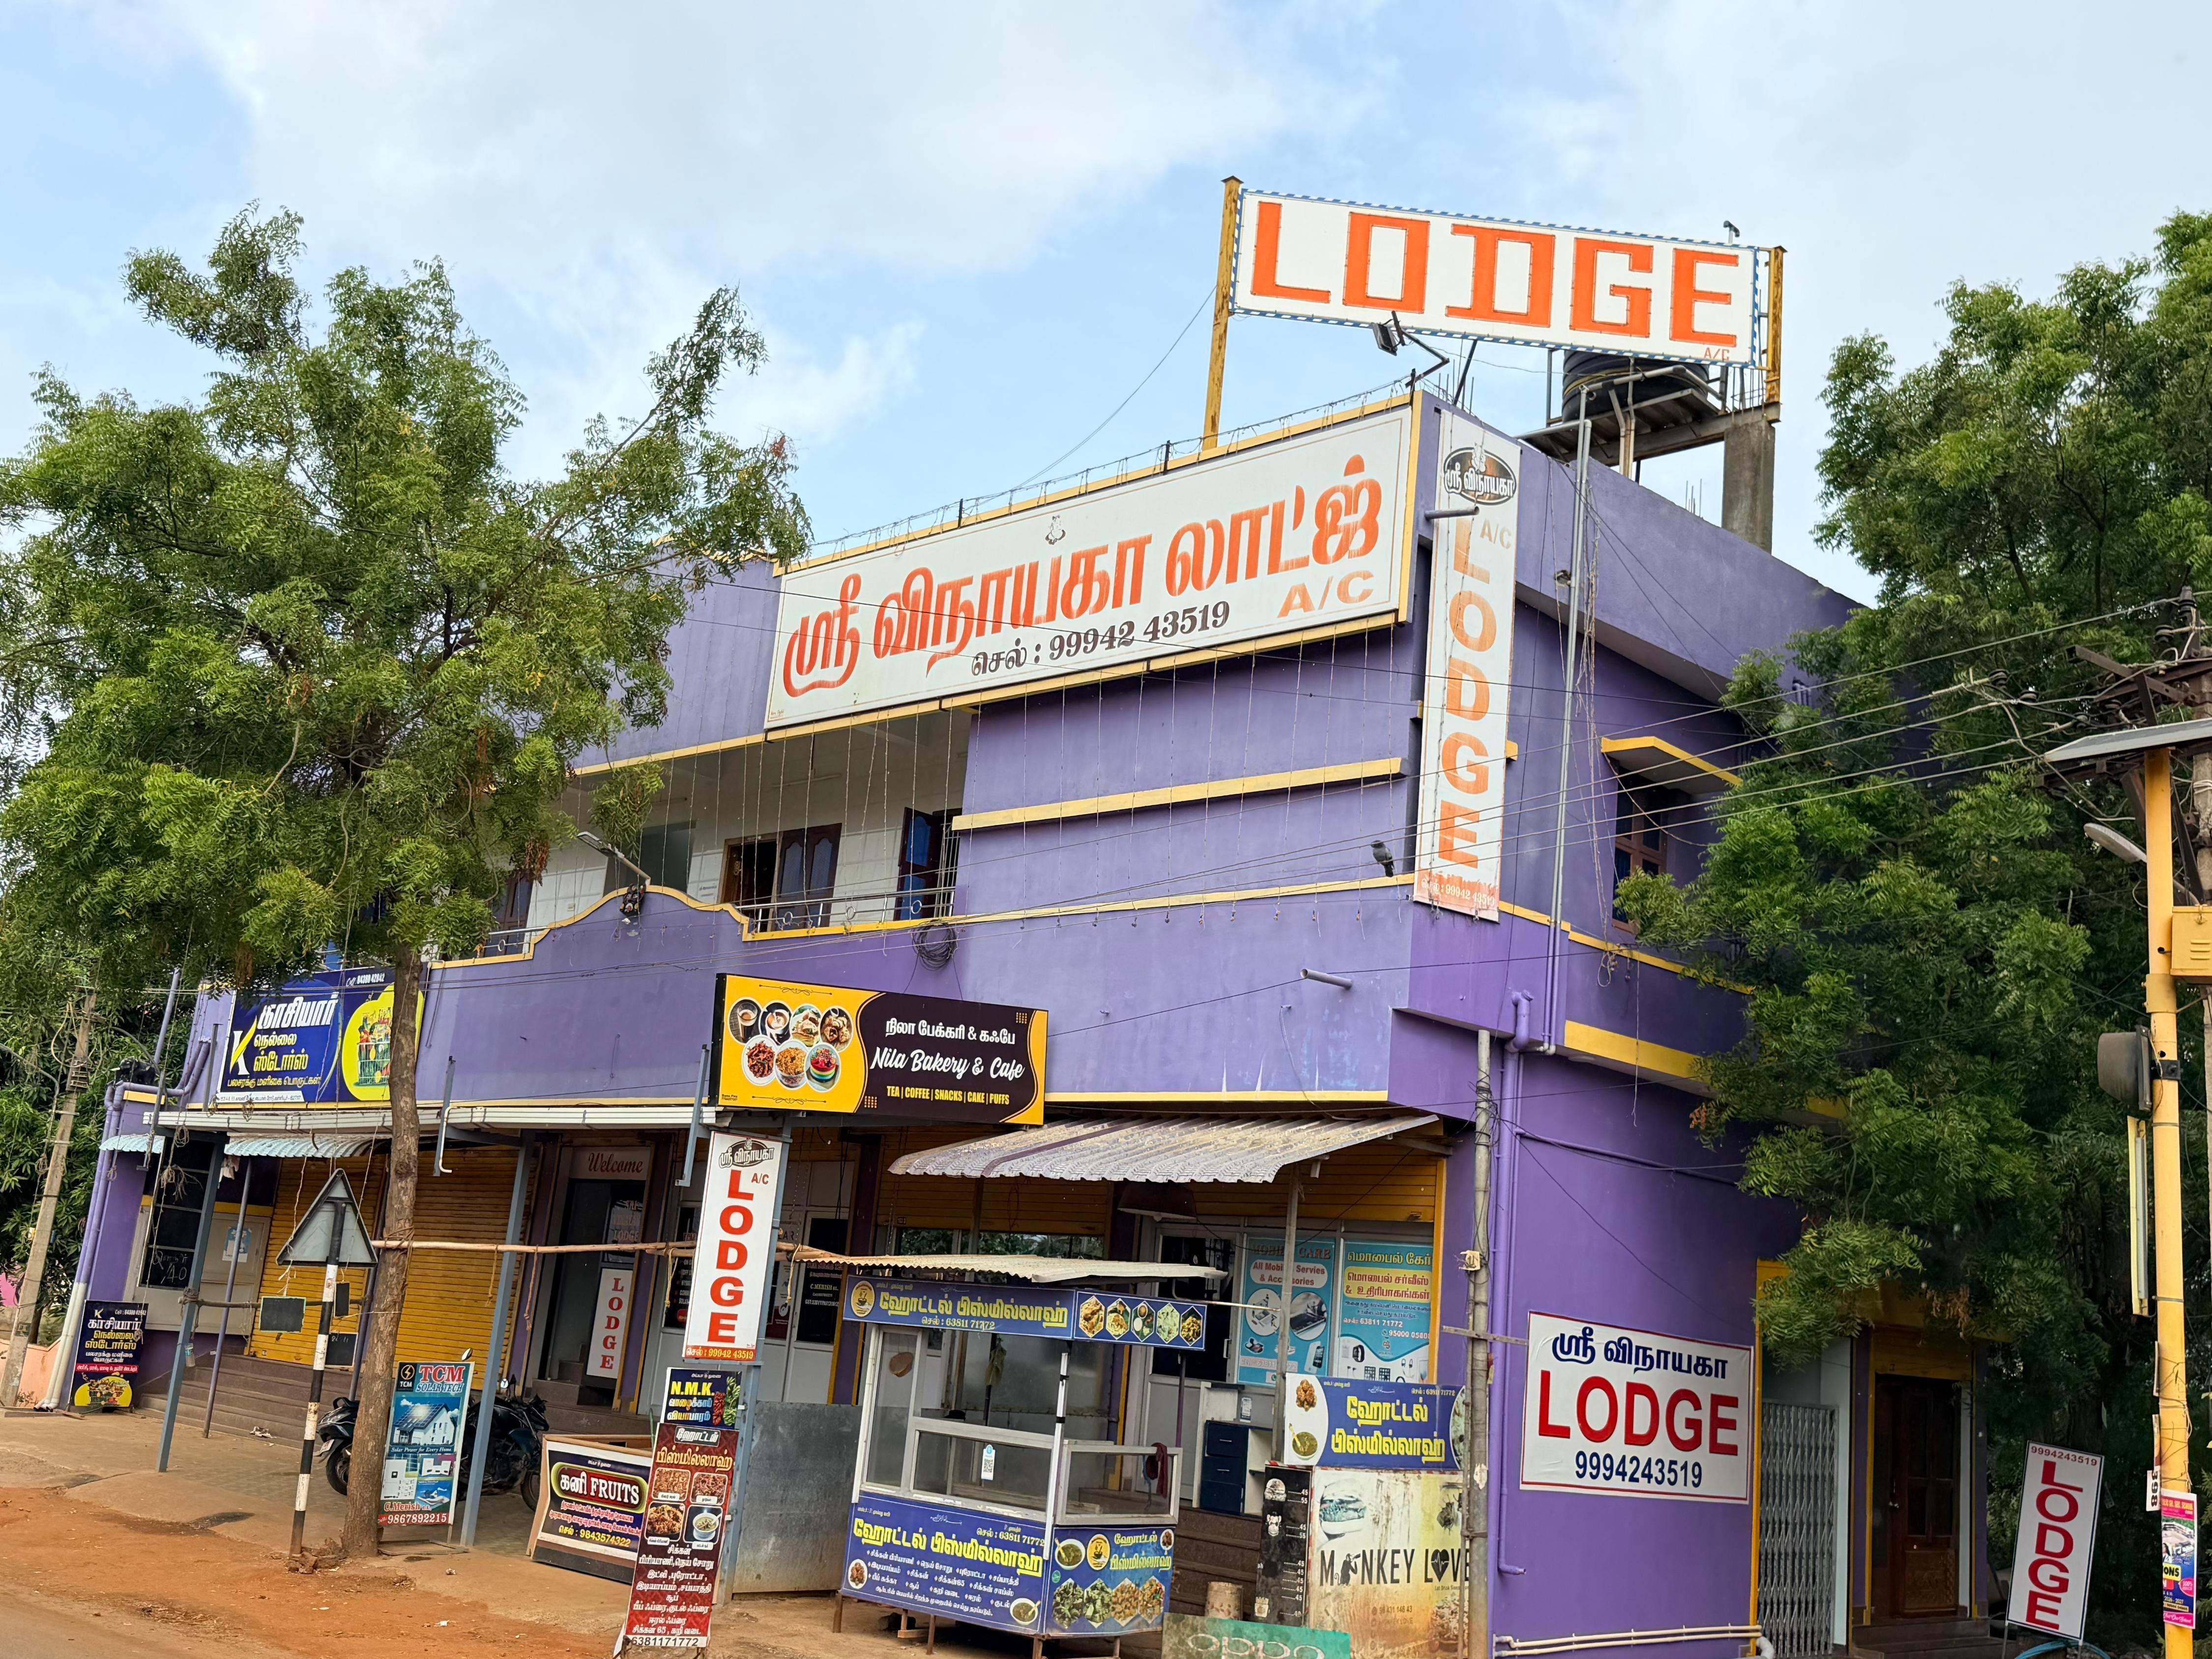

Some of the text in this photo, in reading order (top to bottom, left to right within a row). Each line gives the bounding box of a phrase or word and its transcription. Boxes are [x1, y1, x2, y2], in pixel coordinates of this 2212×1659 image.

[1251, 201, 1739, 347] LODGE
[1704, 348, 1730, 361] A/C
[1464, 467, 1513, 497] விநாயகா
[1481, 519, 1512, 550] A/C
[874, 534, 1152, 677] விநாயகா
[1166, 455, 1381, 596] லாட்ஜ்
[1279, 571, 1374, 617] A/C
[1049, 621, 1135, 662] 99942
[1144, 600, 1229, 641] 43519
[1438, 514, 1496, 869] LODGE
[258, 992, 339, 1029] காசியார்
[255, 1032, 297, 1050] நெல்லை
[885, 1018, 1015, 1045] நிலா பேக்கரி & கஃபே
[870, 1047, 1025, 1081] Nila Bakery & Cafe
[887, 1086, 1010, 1105] TEA COFFEE SNACKS CAKE PUFFS
[588, 1152, 643, 1174] Welcome
[734, 1146, 774, 1164] விநாயகா
[751, 1172, 769, 1185] A/C
[707, 1169, 754, 1343] LODGE
[1299, 1247, 1331, 1259] CARE
[1347, 1252, 1403, 1263] மொபைல்
[1296, 1265, 1325, 1274] Servies
[1348, 1272, 1428, 1285] மொபைல் சர்வீஸ்
[1346, 1285, 1352, 1294] &
[879, 1292, 1068, 1328] ஹோட்டல் பிஸ்மில்லாஹ்
[88, 1317, 142, 1330] காசியார்
[600, 1278, 624, 1369] LODGE
[946, 1318, 968, 1328] 63811
[93, 1330, 134, 1339] நெல்லை
[708, 1348, 731, 1358] 99942
[733, 1350, 754, 1359] 43519
[1604, 1336, 1728, 1379] விநாயகா
[419, 1366, 466, 1382] TCM
[416, 1383, 463, 1392] SOLAR TECH
[670, 1381, 715, 1396] N.M.K.
[1347, 1396, 1428, 1427] ஹோட்டல்
[1539, 1370, 1738, 1456] LODGE
[676, 1428, 719, 1443] ஹோட்டல்
[1331, 1428, 1445, 1464] பிஸ்மில்லாஹ்
[2031, 1446, 2097, 1466] 9994243519
[1575, 1451, 1702, 1488] 9994243519
[560, 1471, 639, 1505] கனி FRUITS
[388, 1513, 447, 1524] 9867892215
[580, 1529, 631, 1547] 9843574322
[853, 1518, 1043, 1577] ஹோட்டல் பிஸ்மில்லாஹ்
[1114, 1531, 1158, 1547] ஹோட்டல்
[2026, 1460, 2083, 1630] LODGE
[1109, 1550, 1172, 1572] பிஸ்மில்லாஹ்
[632, 1637, 699, 1647] 6381171772
